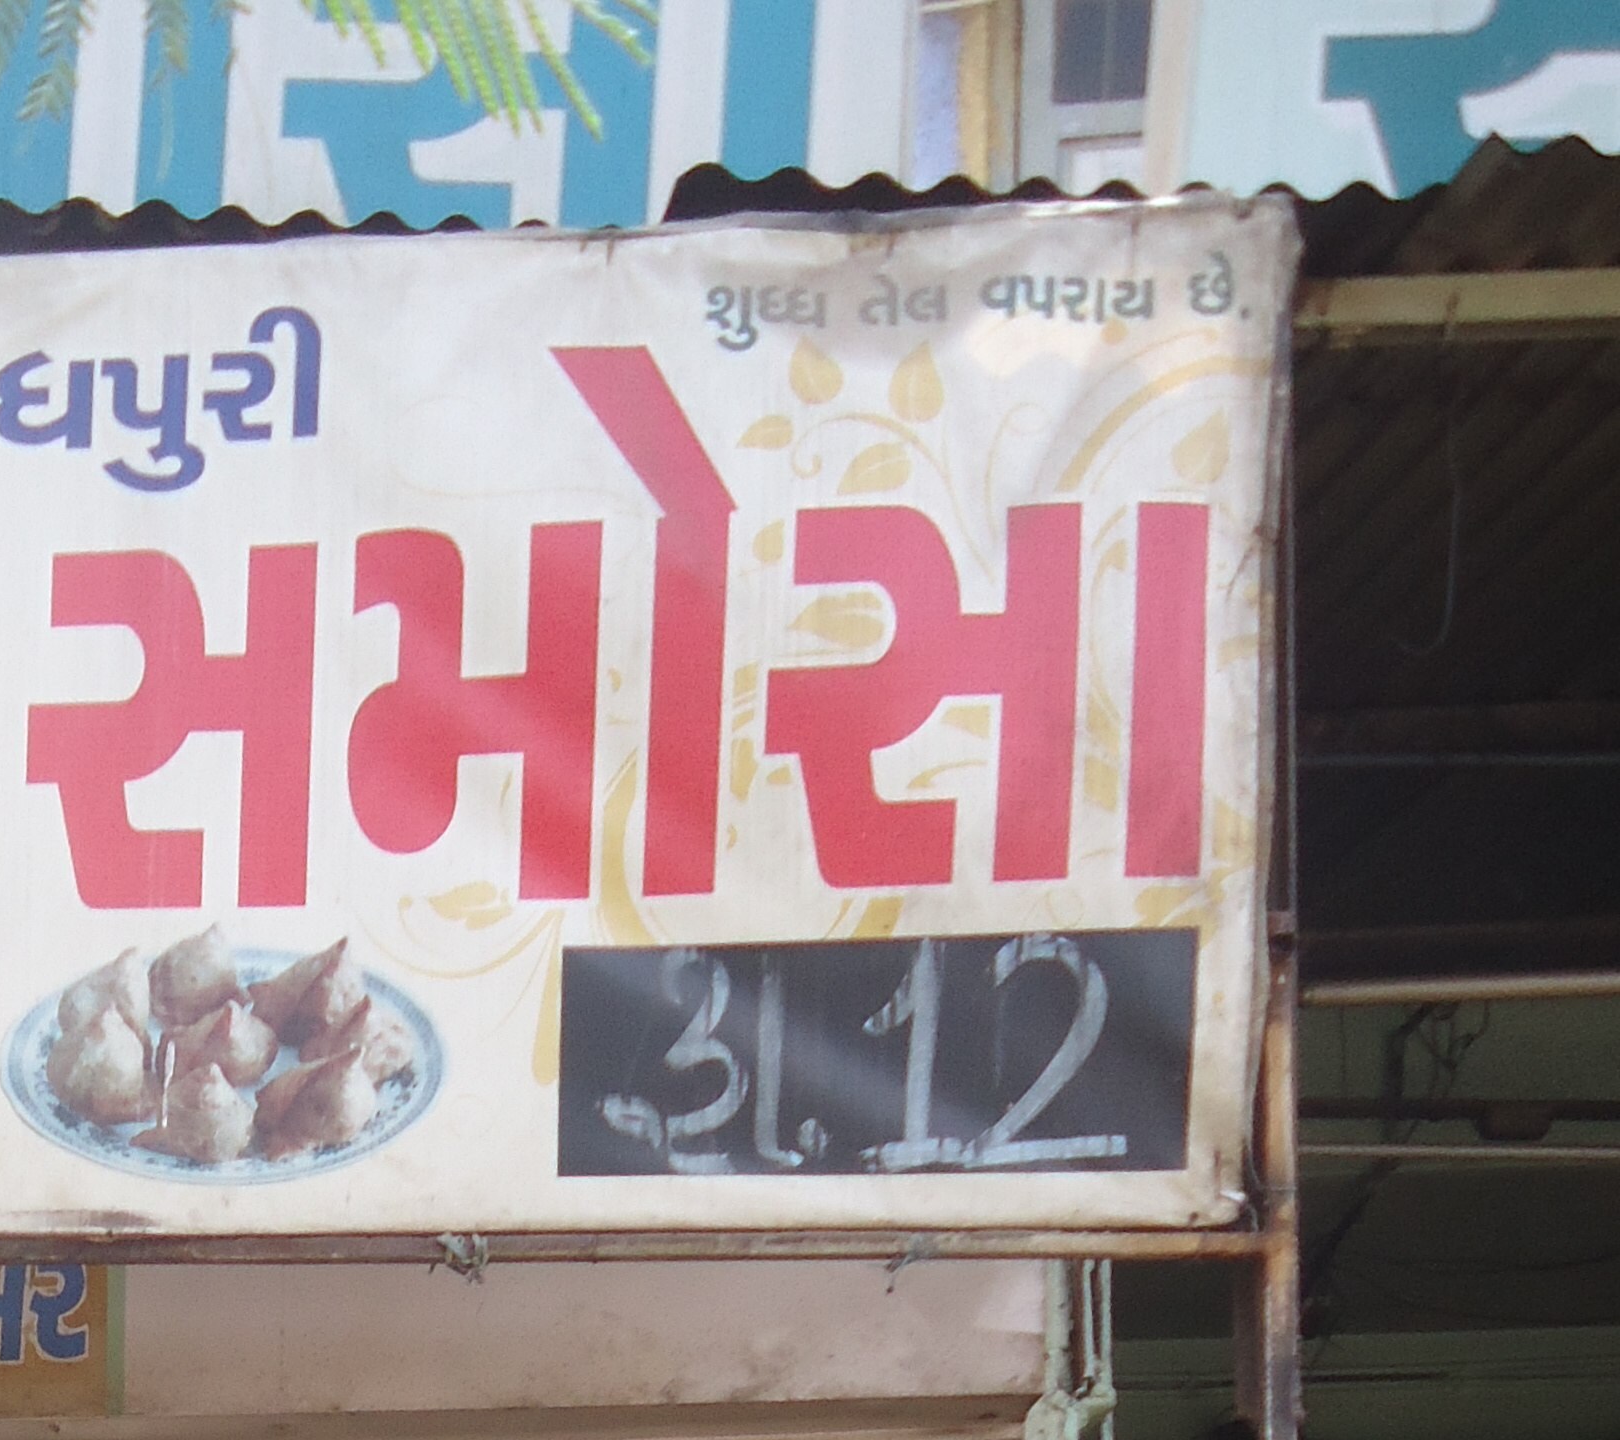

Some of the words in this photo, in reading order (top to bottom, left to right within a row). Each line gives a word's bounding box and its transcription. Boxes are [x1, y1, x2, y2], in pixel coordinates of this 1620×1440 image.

[706, 283, 827, 352] શુધ્ધ
[857, 272, 949, 327] તેલ
[980, 274, 1155, 324] વપરાય
[1186, 249, 1252, 321] છે.
[858, 934, 1128, 1173] 12
